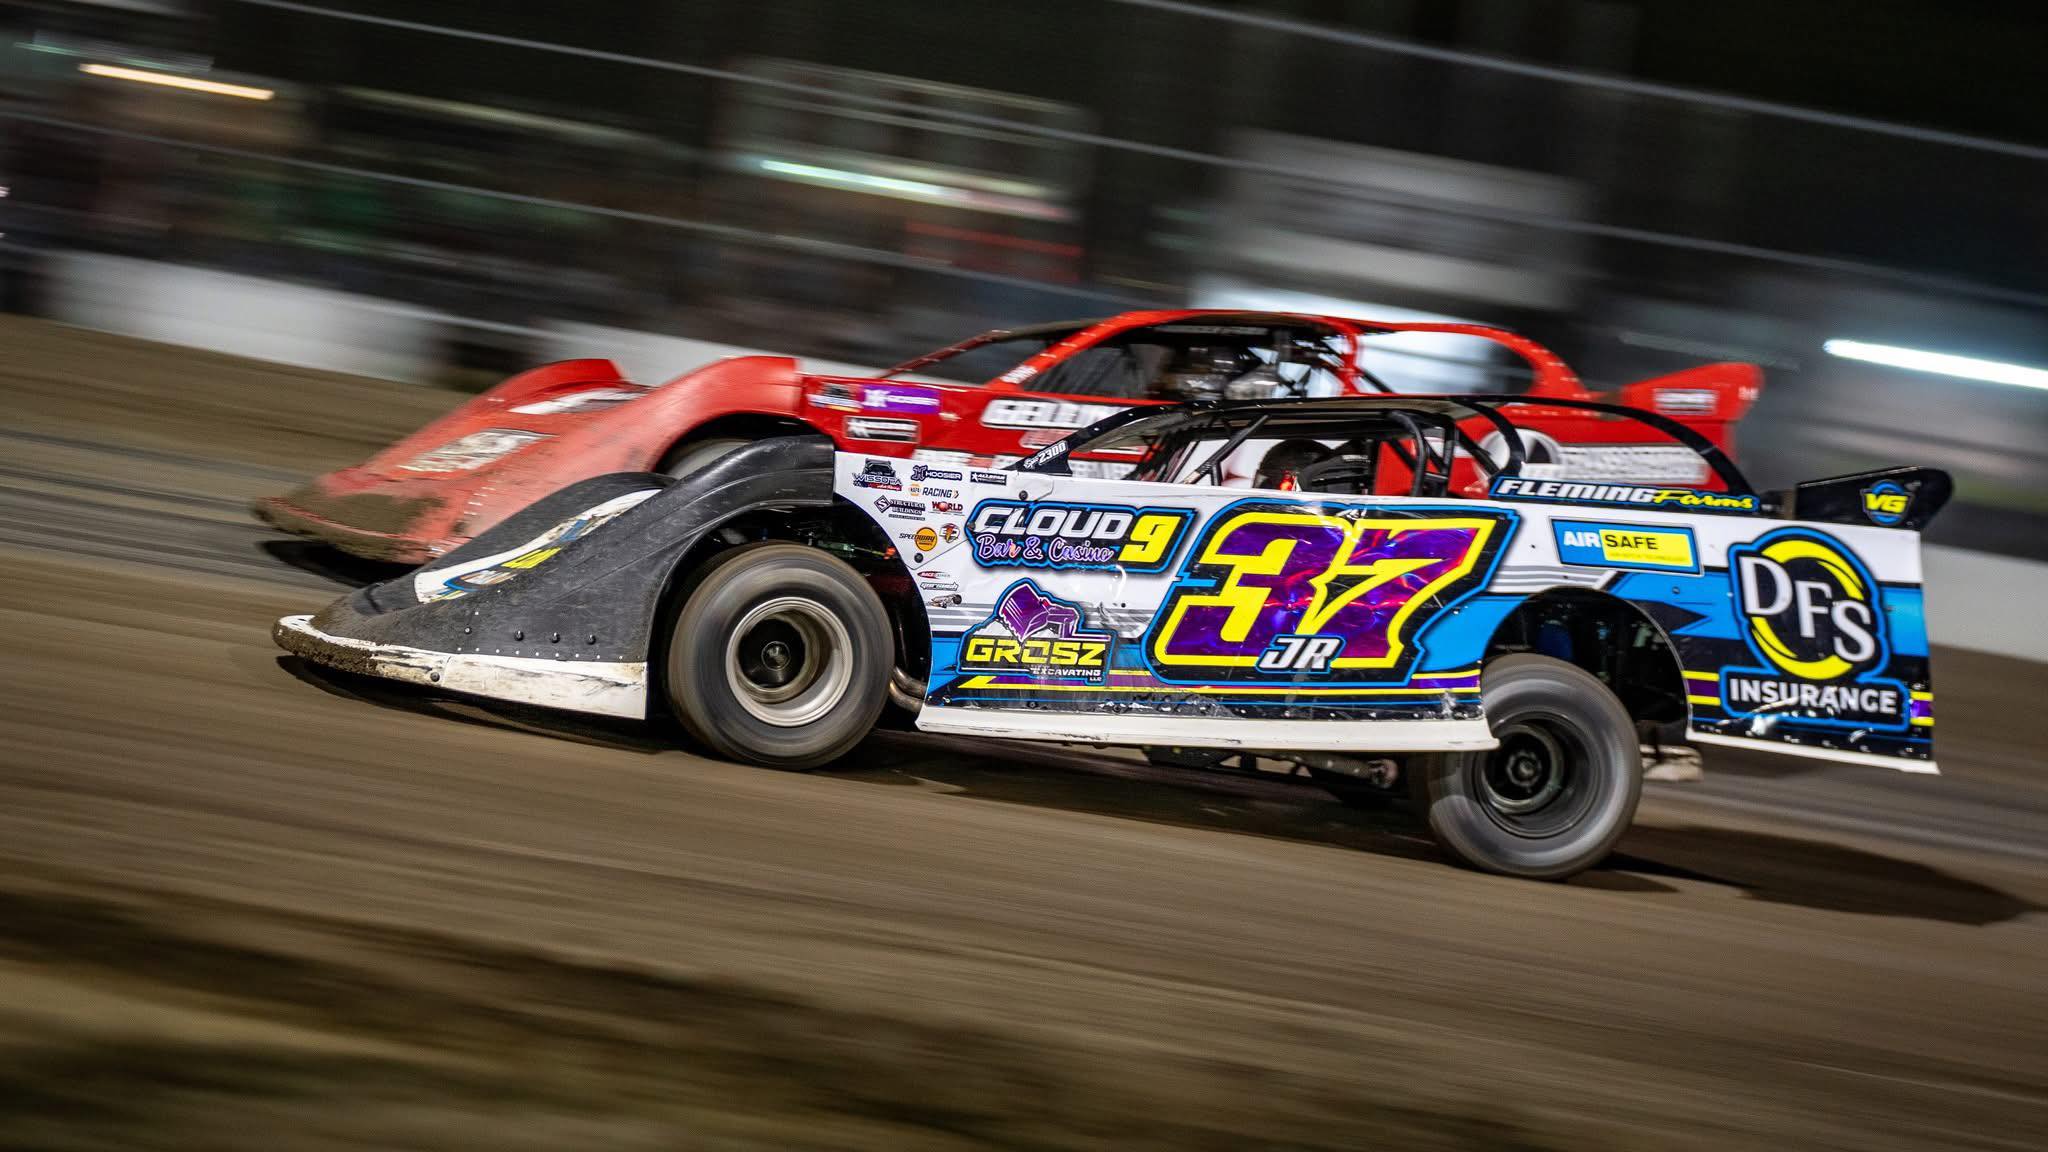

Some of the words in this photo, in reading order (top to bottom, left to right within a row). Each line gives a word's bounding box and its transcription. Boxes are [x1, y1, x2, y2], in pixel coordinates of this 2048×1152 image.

[1039, 440, 1067, 463] 2300
[925, 470, 962, 480] HOOSIER
[922, 487, 952, 499] RACING
[1498, 479, 1654, 502] FLEMING
[1653, 489, 1752, 508] Farms
[1865, 493, 1907, 513] VG
[899, 533, 935, 542] SPEEDWAY
[975, 506, 1132, 540] CLOUD
[1117, 515, 1180, 562] 9
[977, 535, 1021, 559] Bar
[1023, 537, 1043, 559] &
[1050, 537, 1114, 562] Casino
[1155, 511, 1496, 668] 37
[1739, 555, 1876, 662] DFS
[966, 637, 1106, 666] GROSZ
[1257, 637, 1335, 669] JR
[1031, 665, 1101, 677] EXCAVATING
[1730, 678, 1897, 713] INSURANCE
